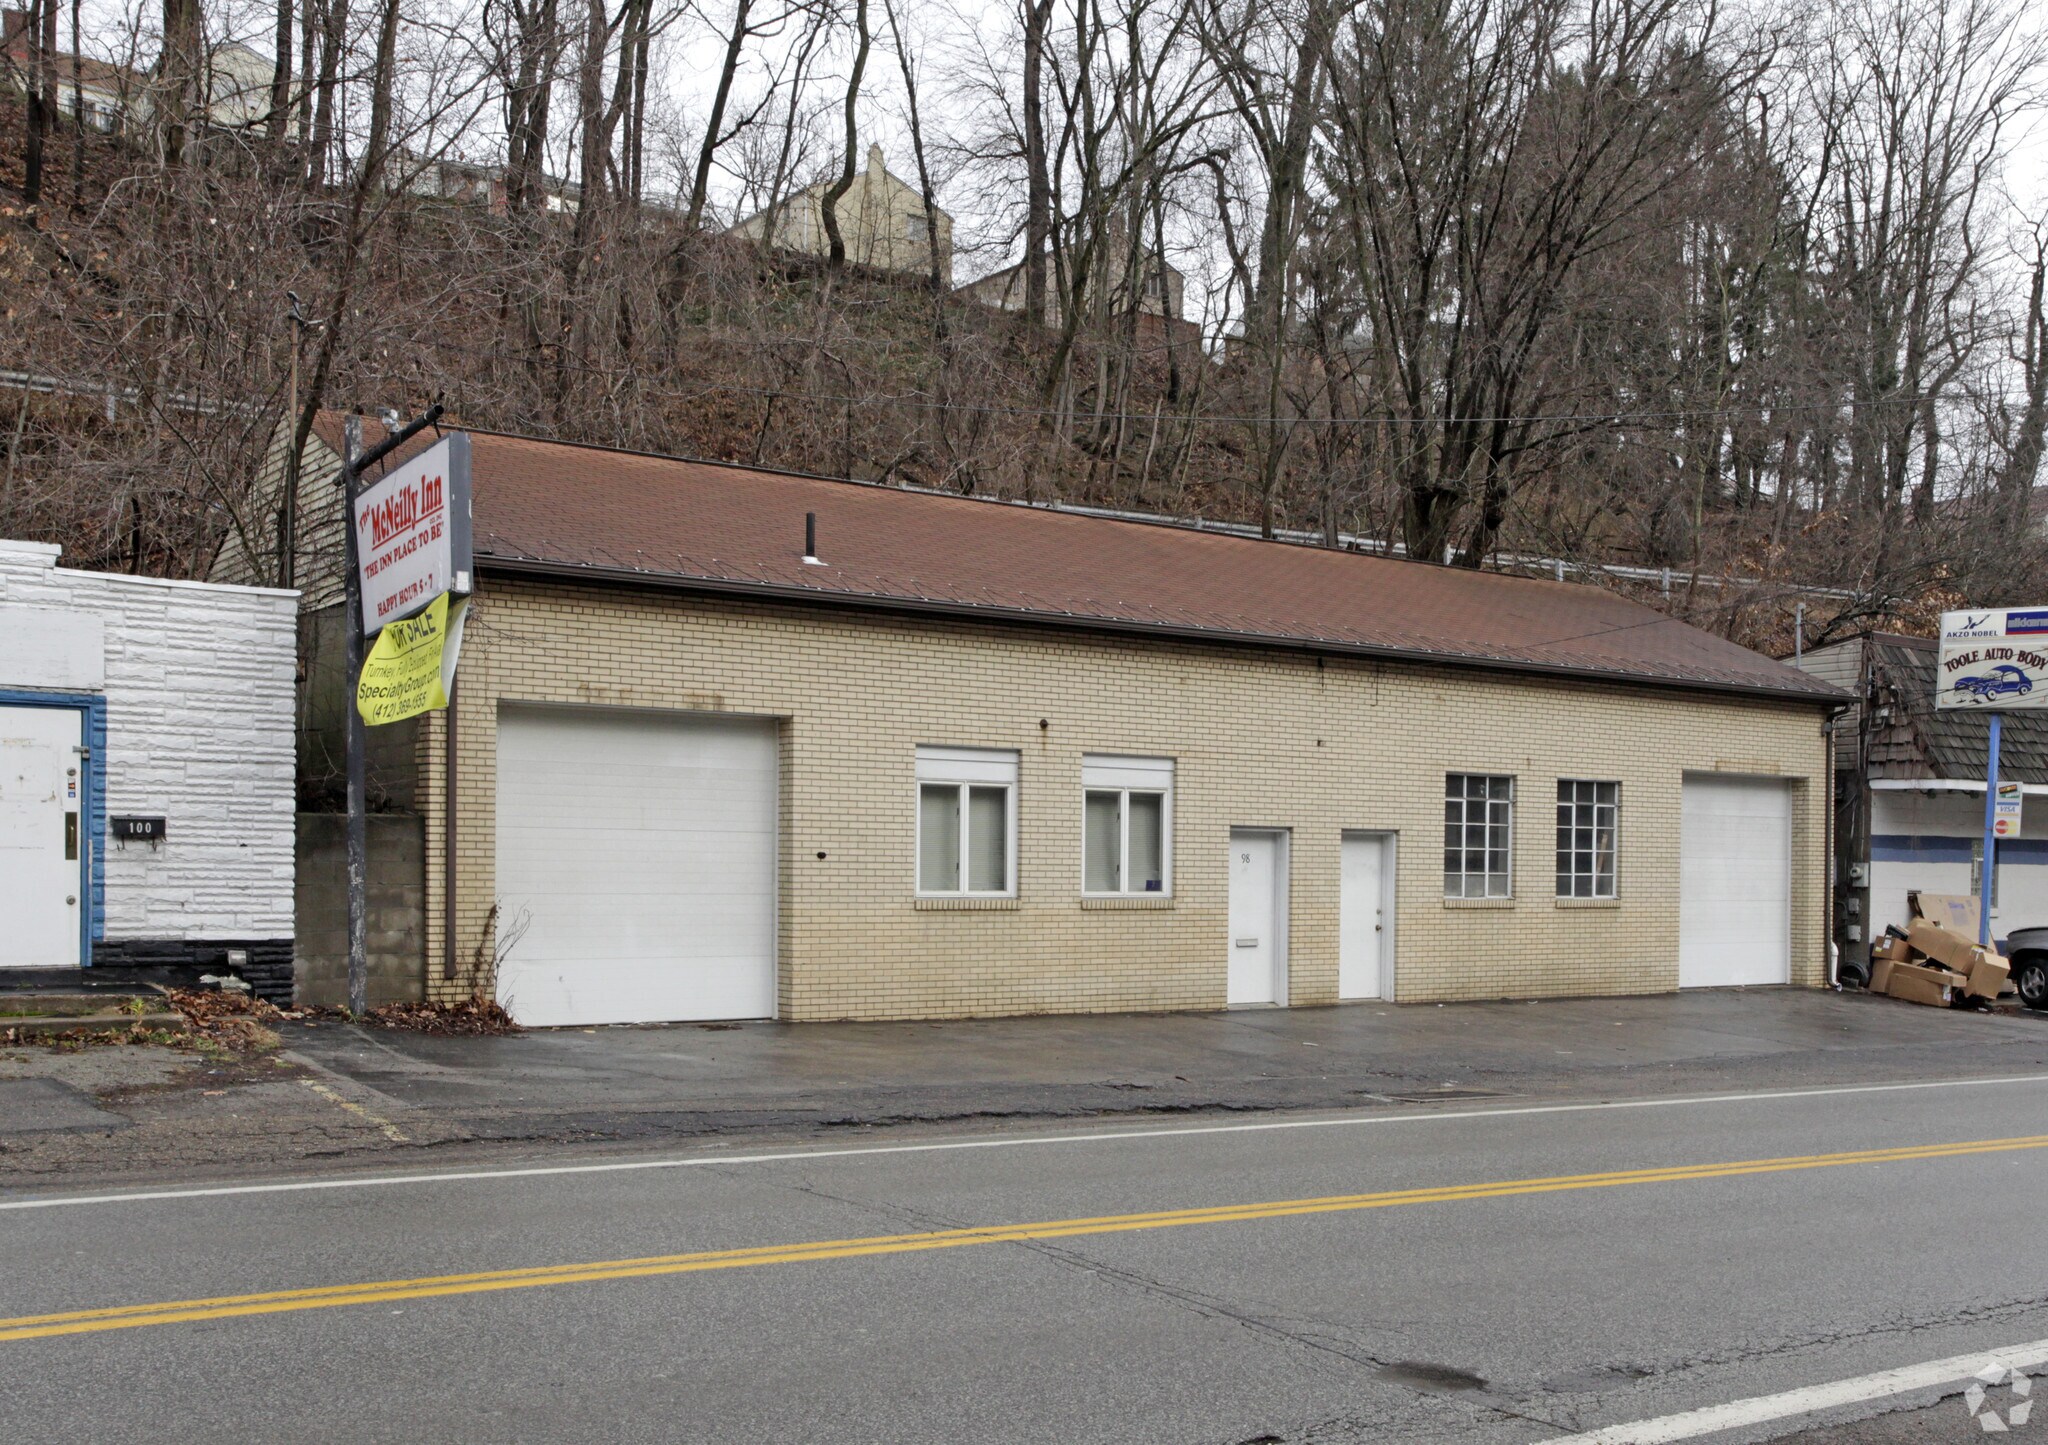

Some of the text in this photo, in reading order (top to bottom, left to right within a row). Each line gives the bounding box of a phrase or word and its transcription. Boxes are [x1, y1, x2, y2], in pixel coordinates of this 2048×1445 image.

[359, 474, 442, 546] The McNeilly Inn
[379, 551, 393, 572] INN
[393, 537, 417, 563] PLACE
[418, 530, 429, 548] TO
[377, 593, 398, 617] HAPPY
[399, 582, 418, 606] HOUR
[428, 573, 433, 589] 7
[406, 611, 436, 643] SALE
[1944, 648, 2048, 673] TOOLE AUTO BODY
[372, 702, 396, 723] (412)
[129, 822, 152, 834] 100
[1241, 853, 1251, 864] 98
